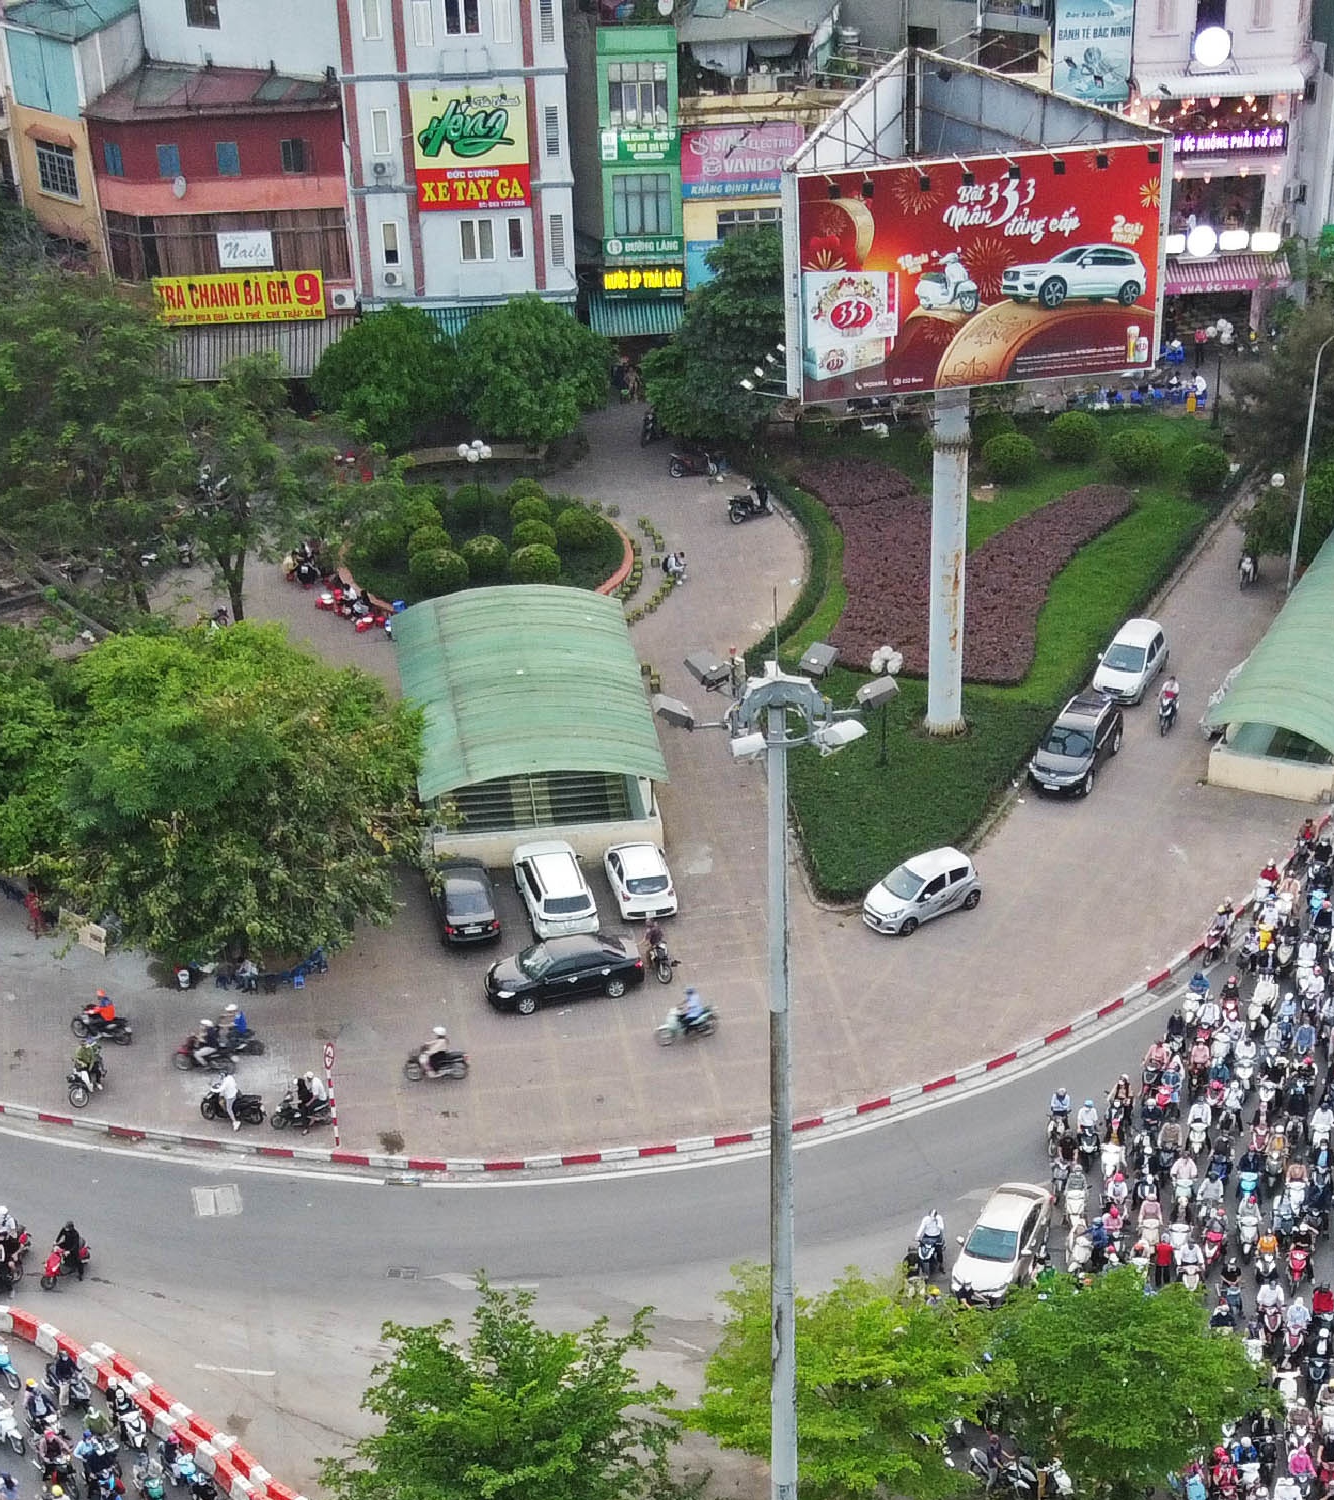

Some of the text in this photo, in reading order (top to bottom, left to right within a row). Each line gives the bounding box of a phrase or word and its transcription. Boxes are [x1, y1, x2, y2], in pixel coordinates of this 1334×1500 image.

[1111, 26, 1131, 38] NINH
[1197, 133, 1229, 151] KHÔNG
[422, 177, 525, 202] XE TAY GA
[957, 184, 984, 206] Bật
[1111, 214, 1125, 232] 2
[223, 241, 268, 260] Nails
[604, 268, 628, 290] NƯỚC
[629, 268, 642, 289] ÉP
[643, 268, 664, 288] TRÁI
[158, 280, 186, 311] TRÀ
[189, 281, 241, 309] CHANH
[244, 276, 264, 307] BÀ
[295, 272, 321, 306] 9
[1180, 284, 1204, 294] VUA
